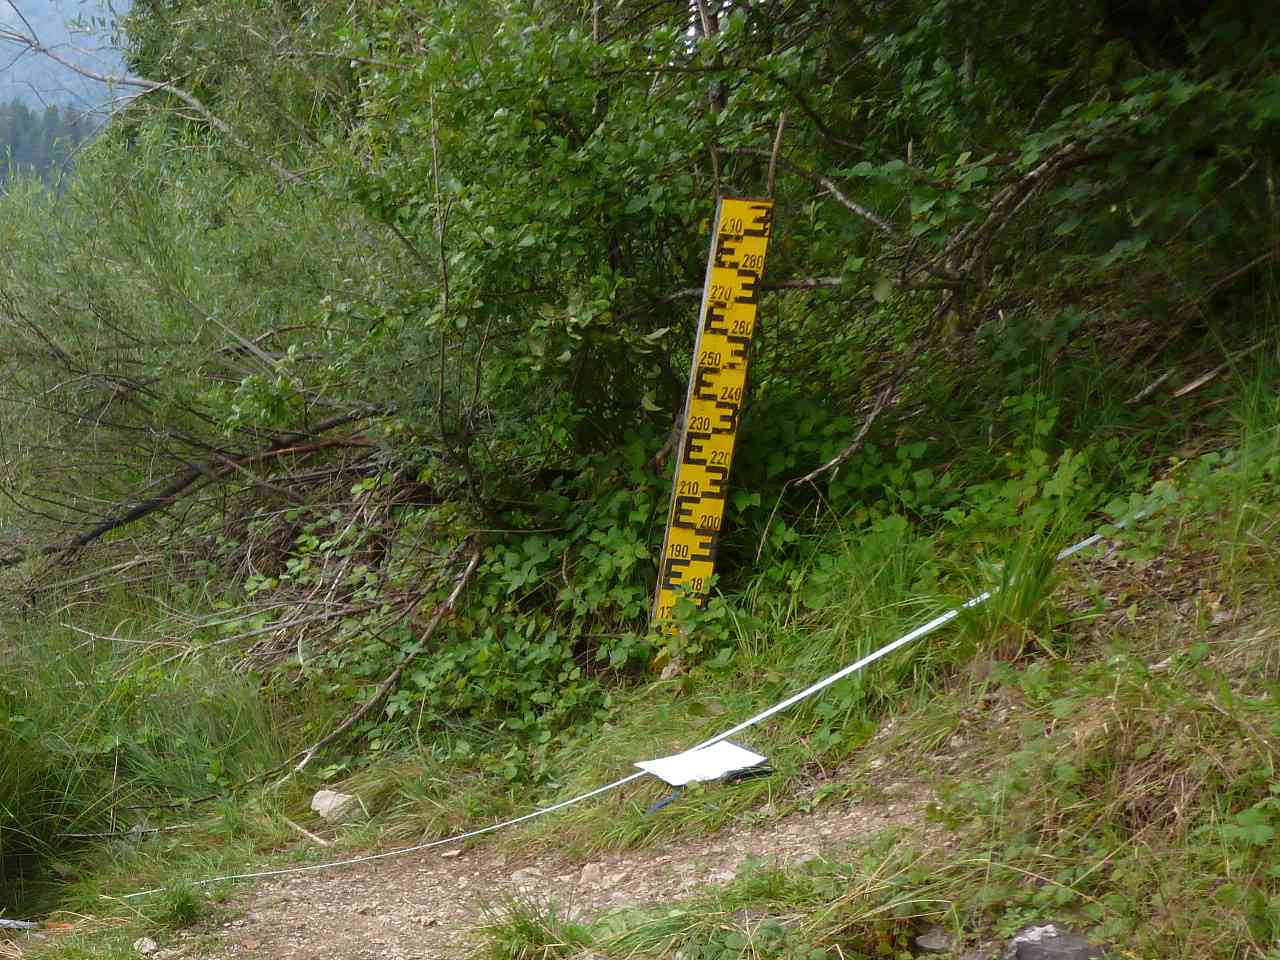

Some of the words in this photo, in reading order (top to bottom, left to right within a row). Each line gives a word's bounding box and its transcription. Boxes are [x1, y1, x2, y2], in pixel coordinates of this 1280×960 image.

[744, 254, 763, 268] 280
[712, 285, 732, 301] 270
[700, 351, 721, 366] 250
[720, 386, 740, 401] 240
[689, 416, 710, 431] 230
[680, 480, 698, 495] 210
[700, 515, 720, 529] 200
[669, 543, 688, 558] 190
[691, 577, 703, 592] 18
